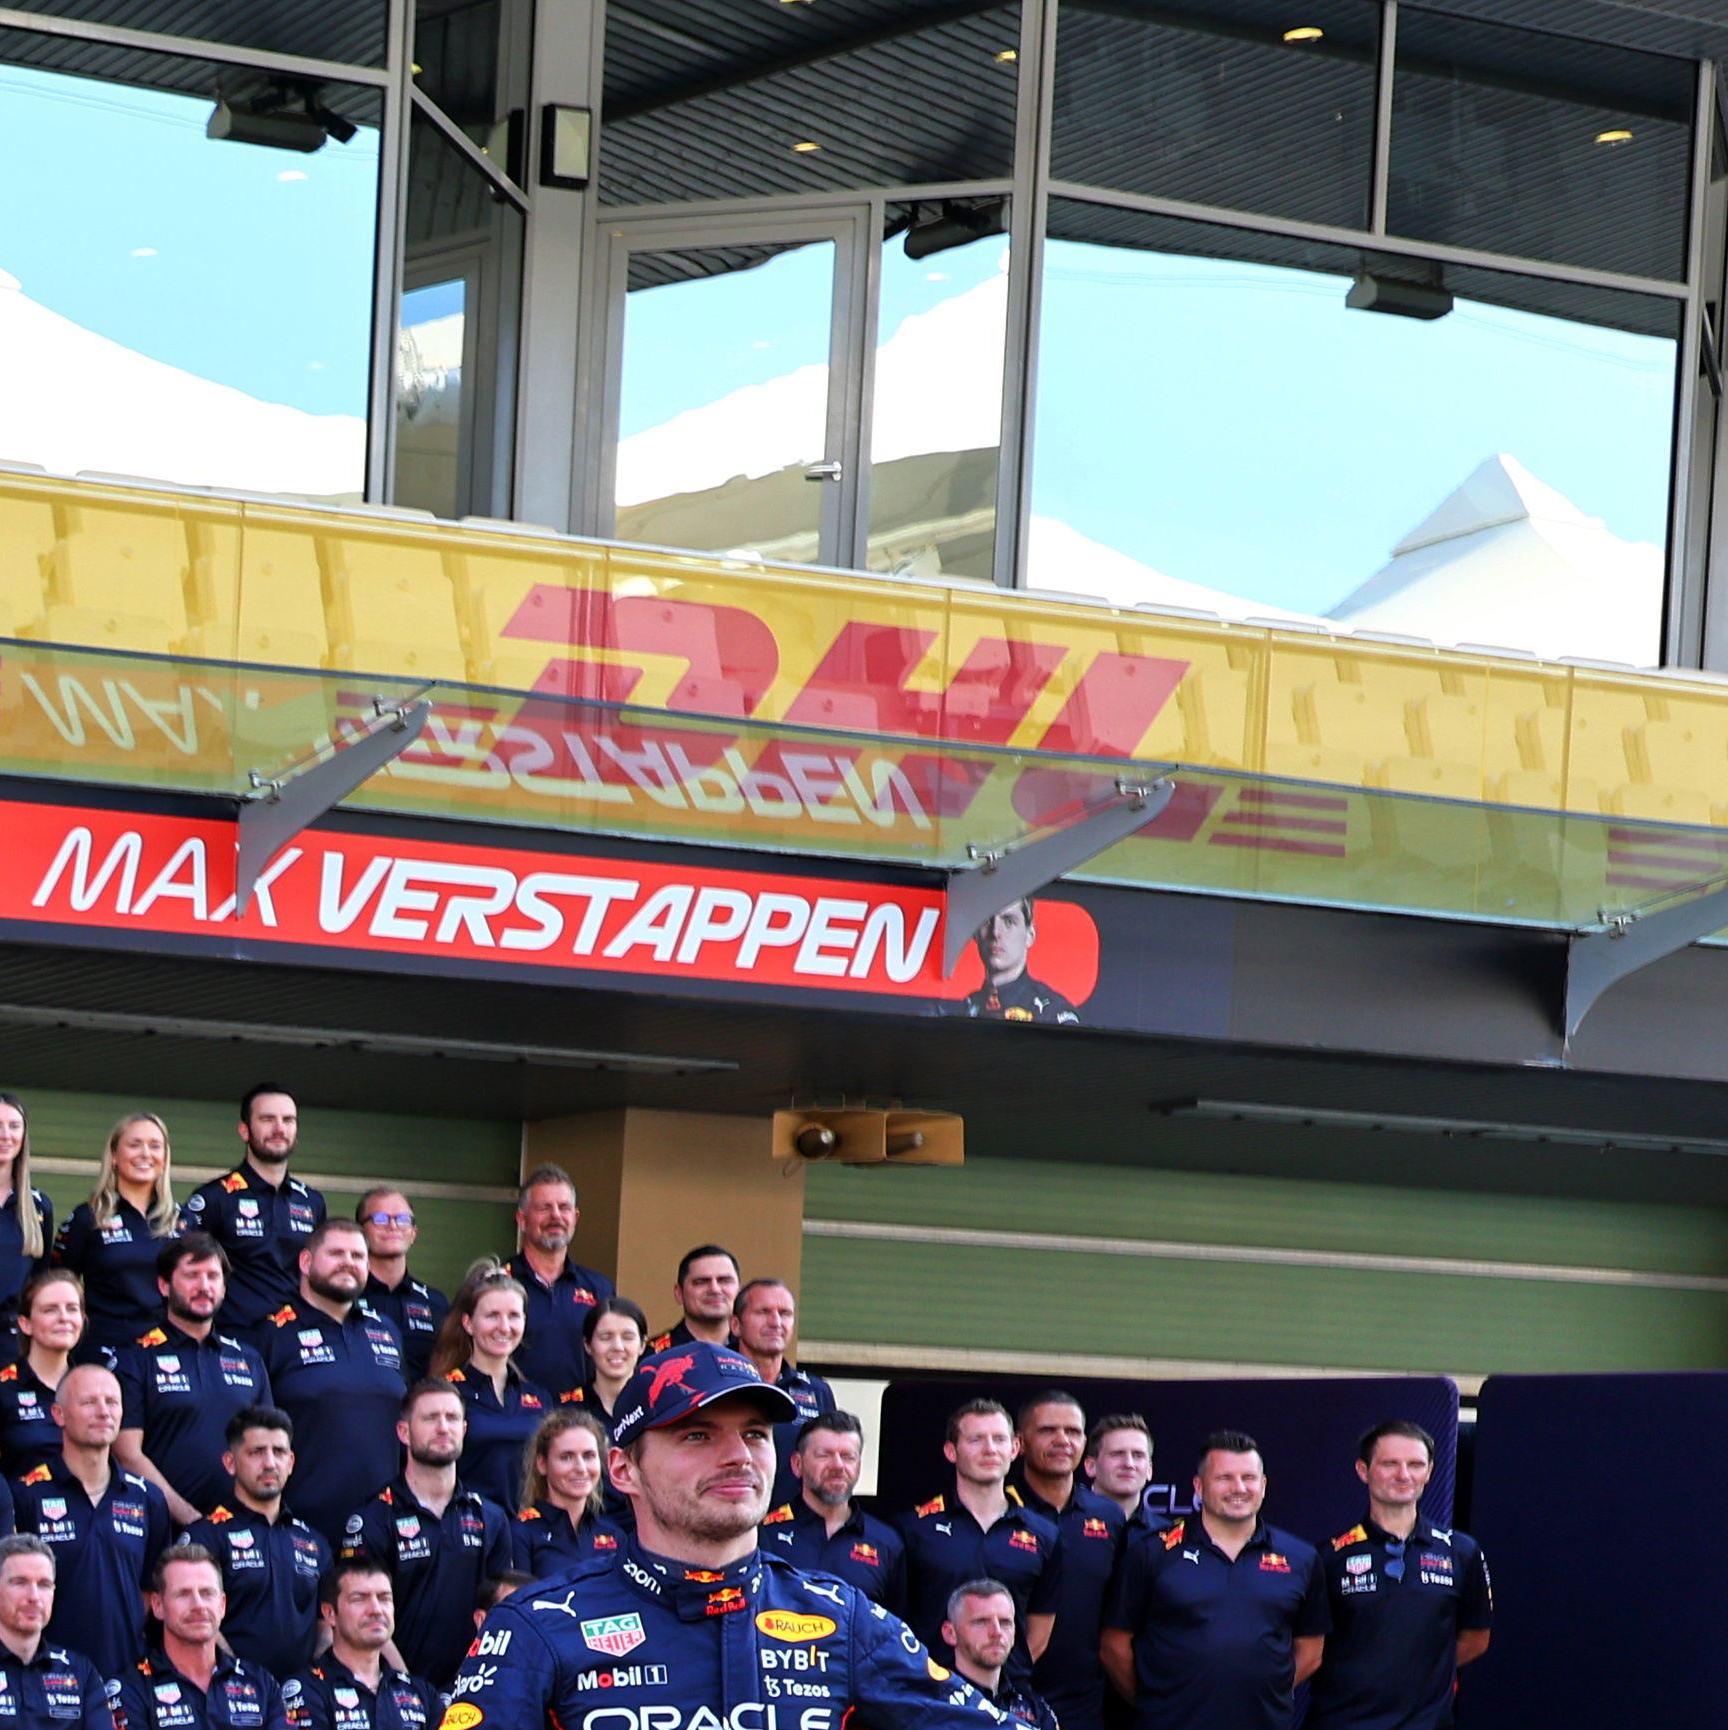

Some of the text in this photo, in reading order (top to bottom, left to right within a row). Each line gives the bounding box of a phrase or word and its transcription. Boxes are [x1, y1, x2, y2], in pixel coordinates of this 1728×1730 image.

[468, 584, 1216, 842] DHL
[33, 827, 945, 986] MAX VERSTAPPEN
[613, 1405, 644, 1442] CarNext
[587, 1615, 637, 1636] TAG
[775, 1620, 824, 1633] RAUCH
[588, 1630, 644, 1652] HEUER
[760, 1644, 829, 1672] BYBIT
[577, 1665, 642, 1691] Mobil
[783, 1679, 830, 1697] Tezos
